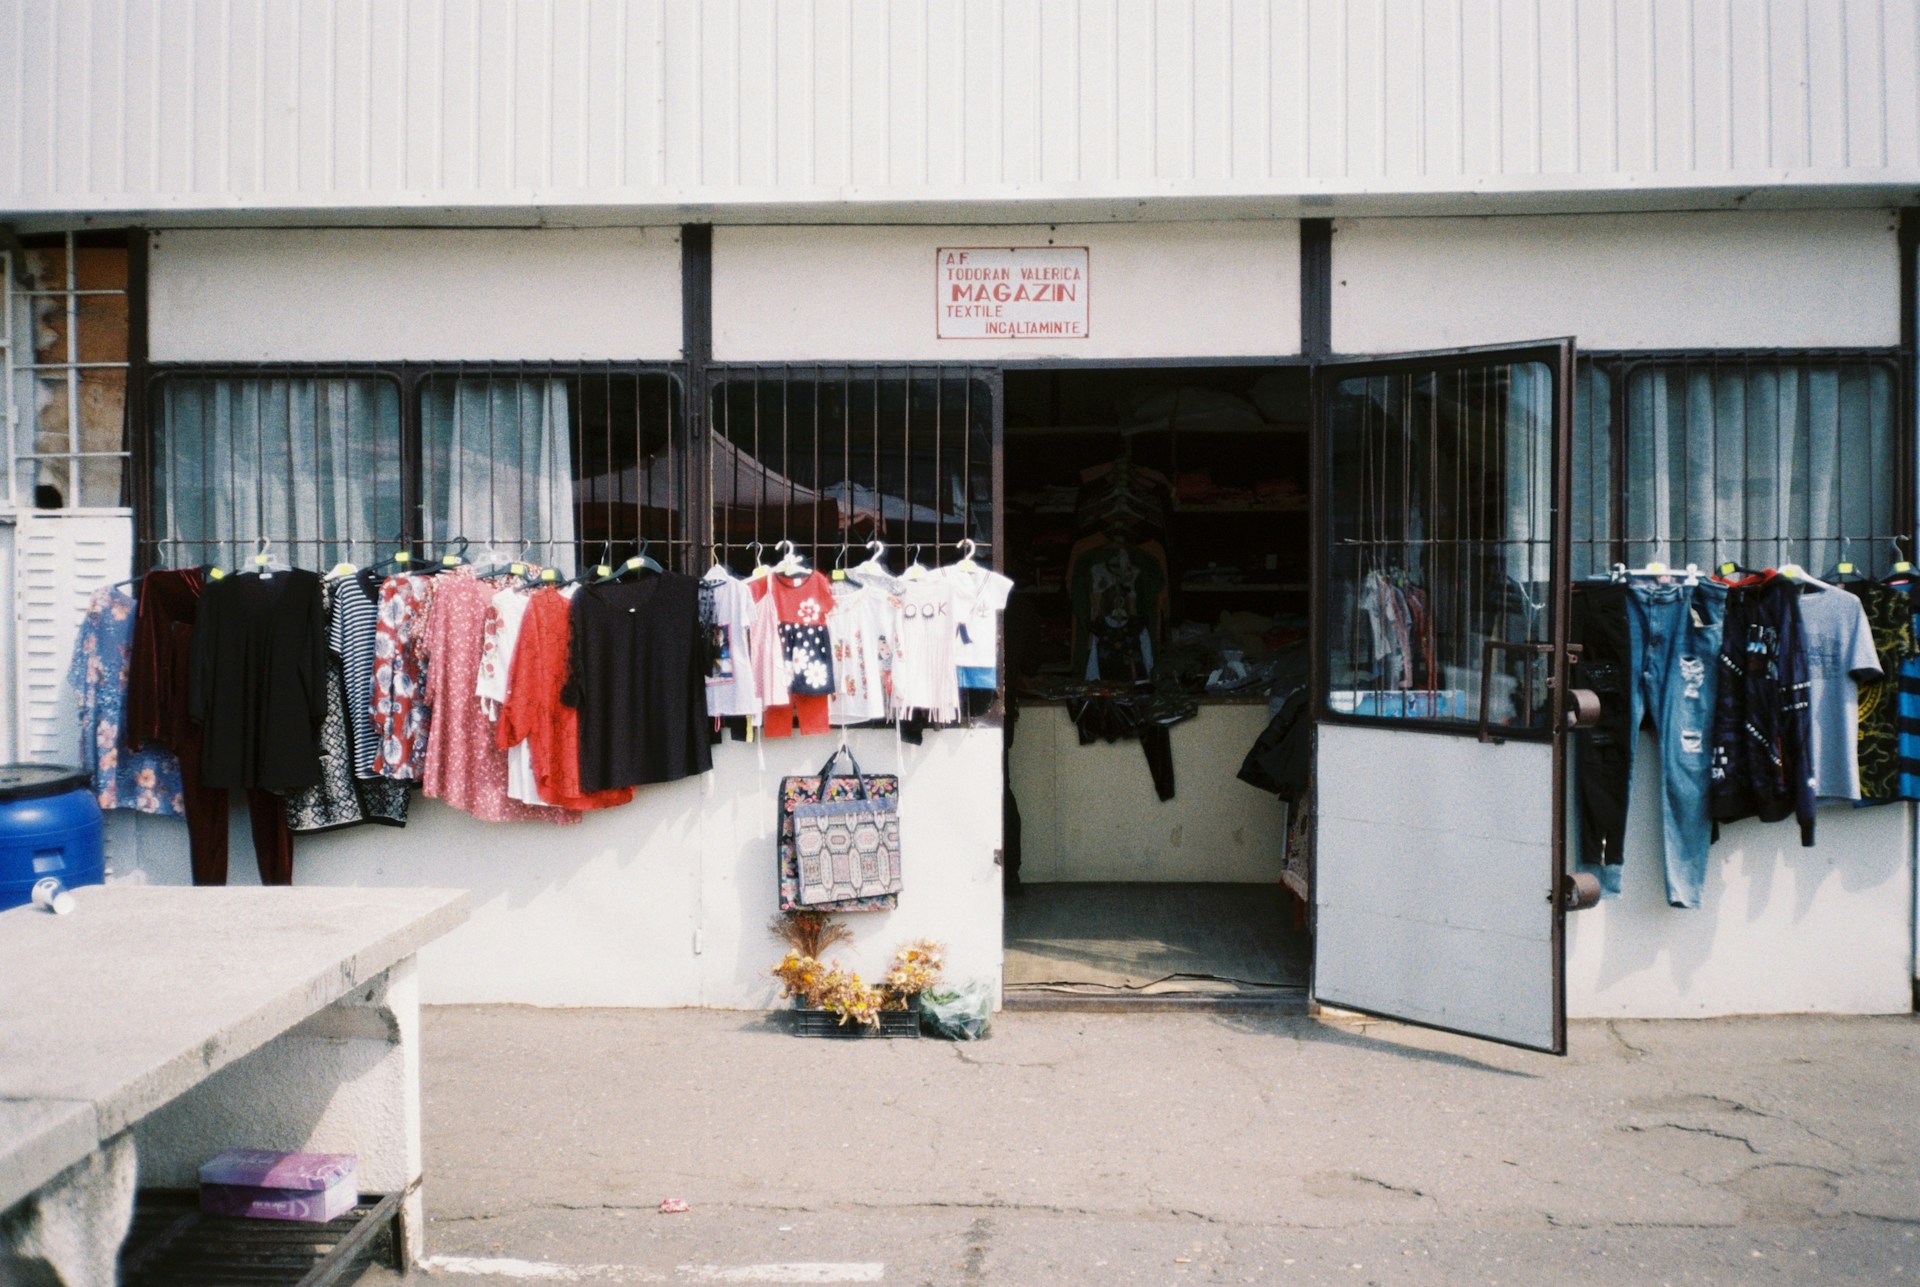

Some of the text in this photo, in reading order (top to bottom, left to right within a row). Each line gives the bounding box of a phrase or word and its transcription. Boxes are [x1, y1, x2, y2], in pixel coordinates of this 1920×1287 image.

[947, 266, 1081, 281] TODORAN VALERICA
[951, 283, 1076, 302] MAGAZIN
[946, 305, 1003, 318] TEXTILE
[985, 321, 1080, 334] INCALTAMINTE
[904, 602, 947, 619] OOK
